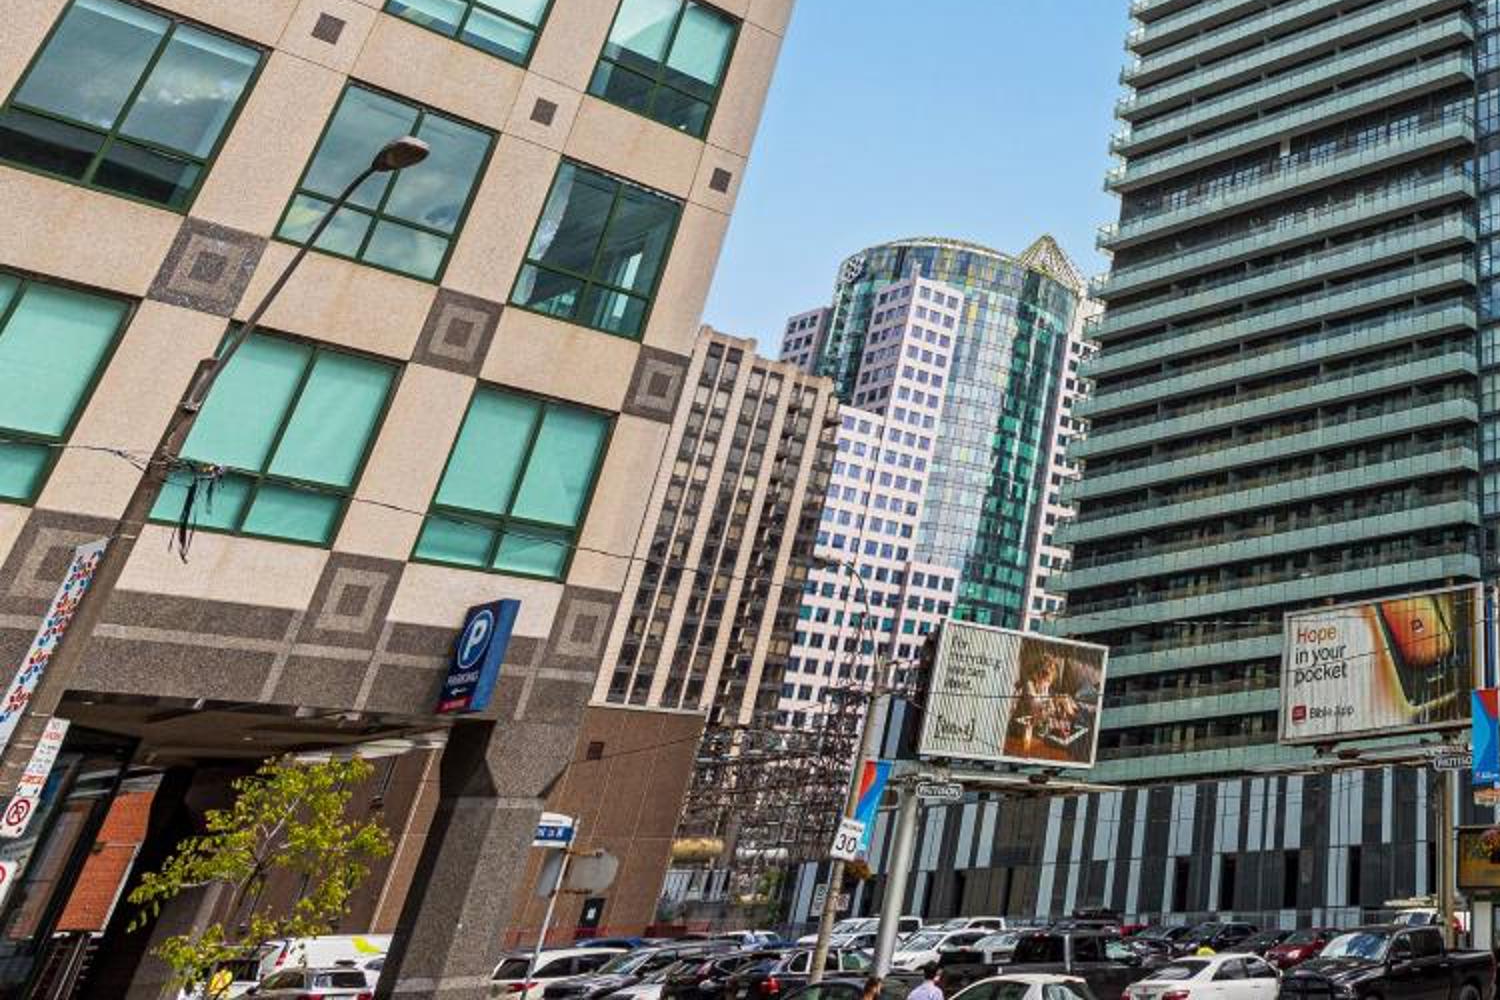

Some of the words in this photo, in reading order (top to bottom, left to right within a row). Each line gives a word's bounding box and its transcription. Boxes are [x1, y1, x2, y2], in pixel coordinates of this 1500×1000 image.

[462, 619, 489, 661] P
[1297, 626, 1337, 645] Hope
[1295, 648, 1309, 665] in
[1311, 645, 1347, 667] your
[1293, 661, 1348, 688] pocket
[835, 833, 858, 853] 30
